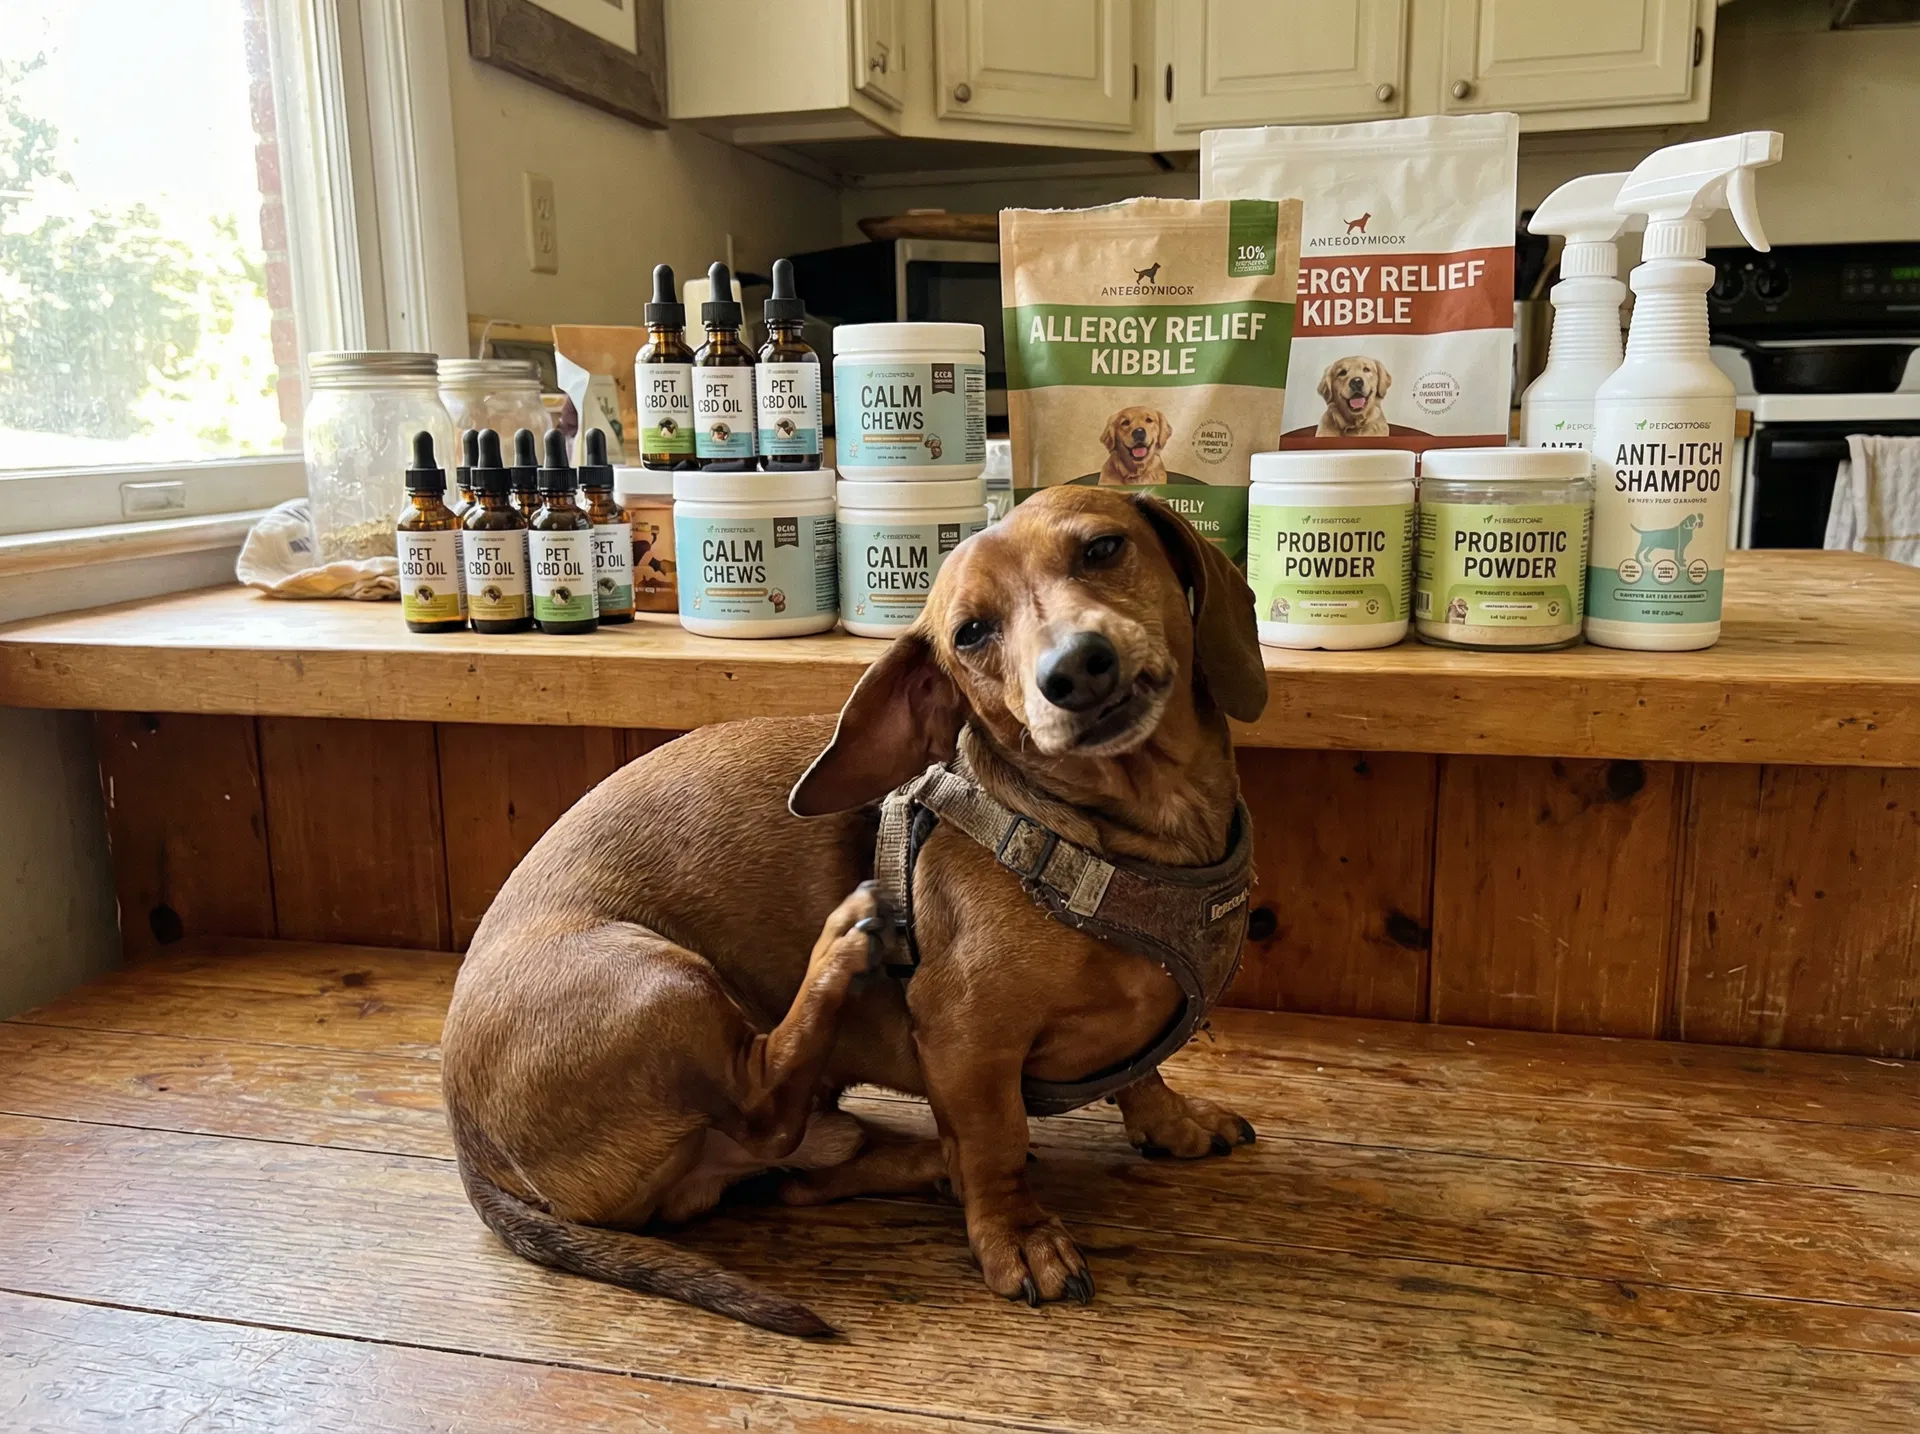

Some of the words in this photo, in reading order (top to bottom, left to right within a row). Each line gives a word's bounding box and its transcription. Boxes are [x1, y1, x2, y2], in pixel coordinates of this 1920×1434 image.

[1237, 245, 1266, 260] 10%
[1380, 259, 1485, 292] RELIEF
[1302, 297, 1412, 327] KIBBLE
[1029, 315, 1157, 345] ALLERGY
[1165, 312, 1266, 343] RELIEF
[1090, 347, 1197, 375] KIBBLE
[653, 380, 677, 393] PET
[705, 384, 728, 398] PET
[771, 380, 795, 393] PET
[645, 394, 668, 409] CBD
[671, 394, 689, 409] OIL
[723, 399, 743, 413] OIL
[788, 394, 808, 409] OIL
[861, 385, 922, 409] CALM
[861, 411, 924, 430] CHEWS
[1615, 442, 1723, 466] ANTI-ITCH
[1615, 468, 1721, 493] SHAMPOO
[702, 539, 764, 563] CALM
[1277, 530, 1386, 553] PROBIOTIC
[1454, 530, 1567, 553] PROBIOTIC
[409, 547, 432, 561] PET
[477, 547, 501, 561] PET
[545, 547, 570, 562] PET
[608, 553, 626, 567] OIL
[866, 545, 928, 569] CALM
[402, 562, 422, 575] CBD
[426, 561, 448, 575] OIL
[469, 562, 490, 575] CBD
[494, 561, 515, 575] OIL
[536, 562, 560, 576] CBD
[563, 561, 584, 576] OIL
[703, 565, 767, 584] CHEWS
[1285, 557, 1375, 578] POWDER
[1464, 557, 1557, 578] POWDER
[867, 571, 930, 590] CHEWS
